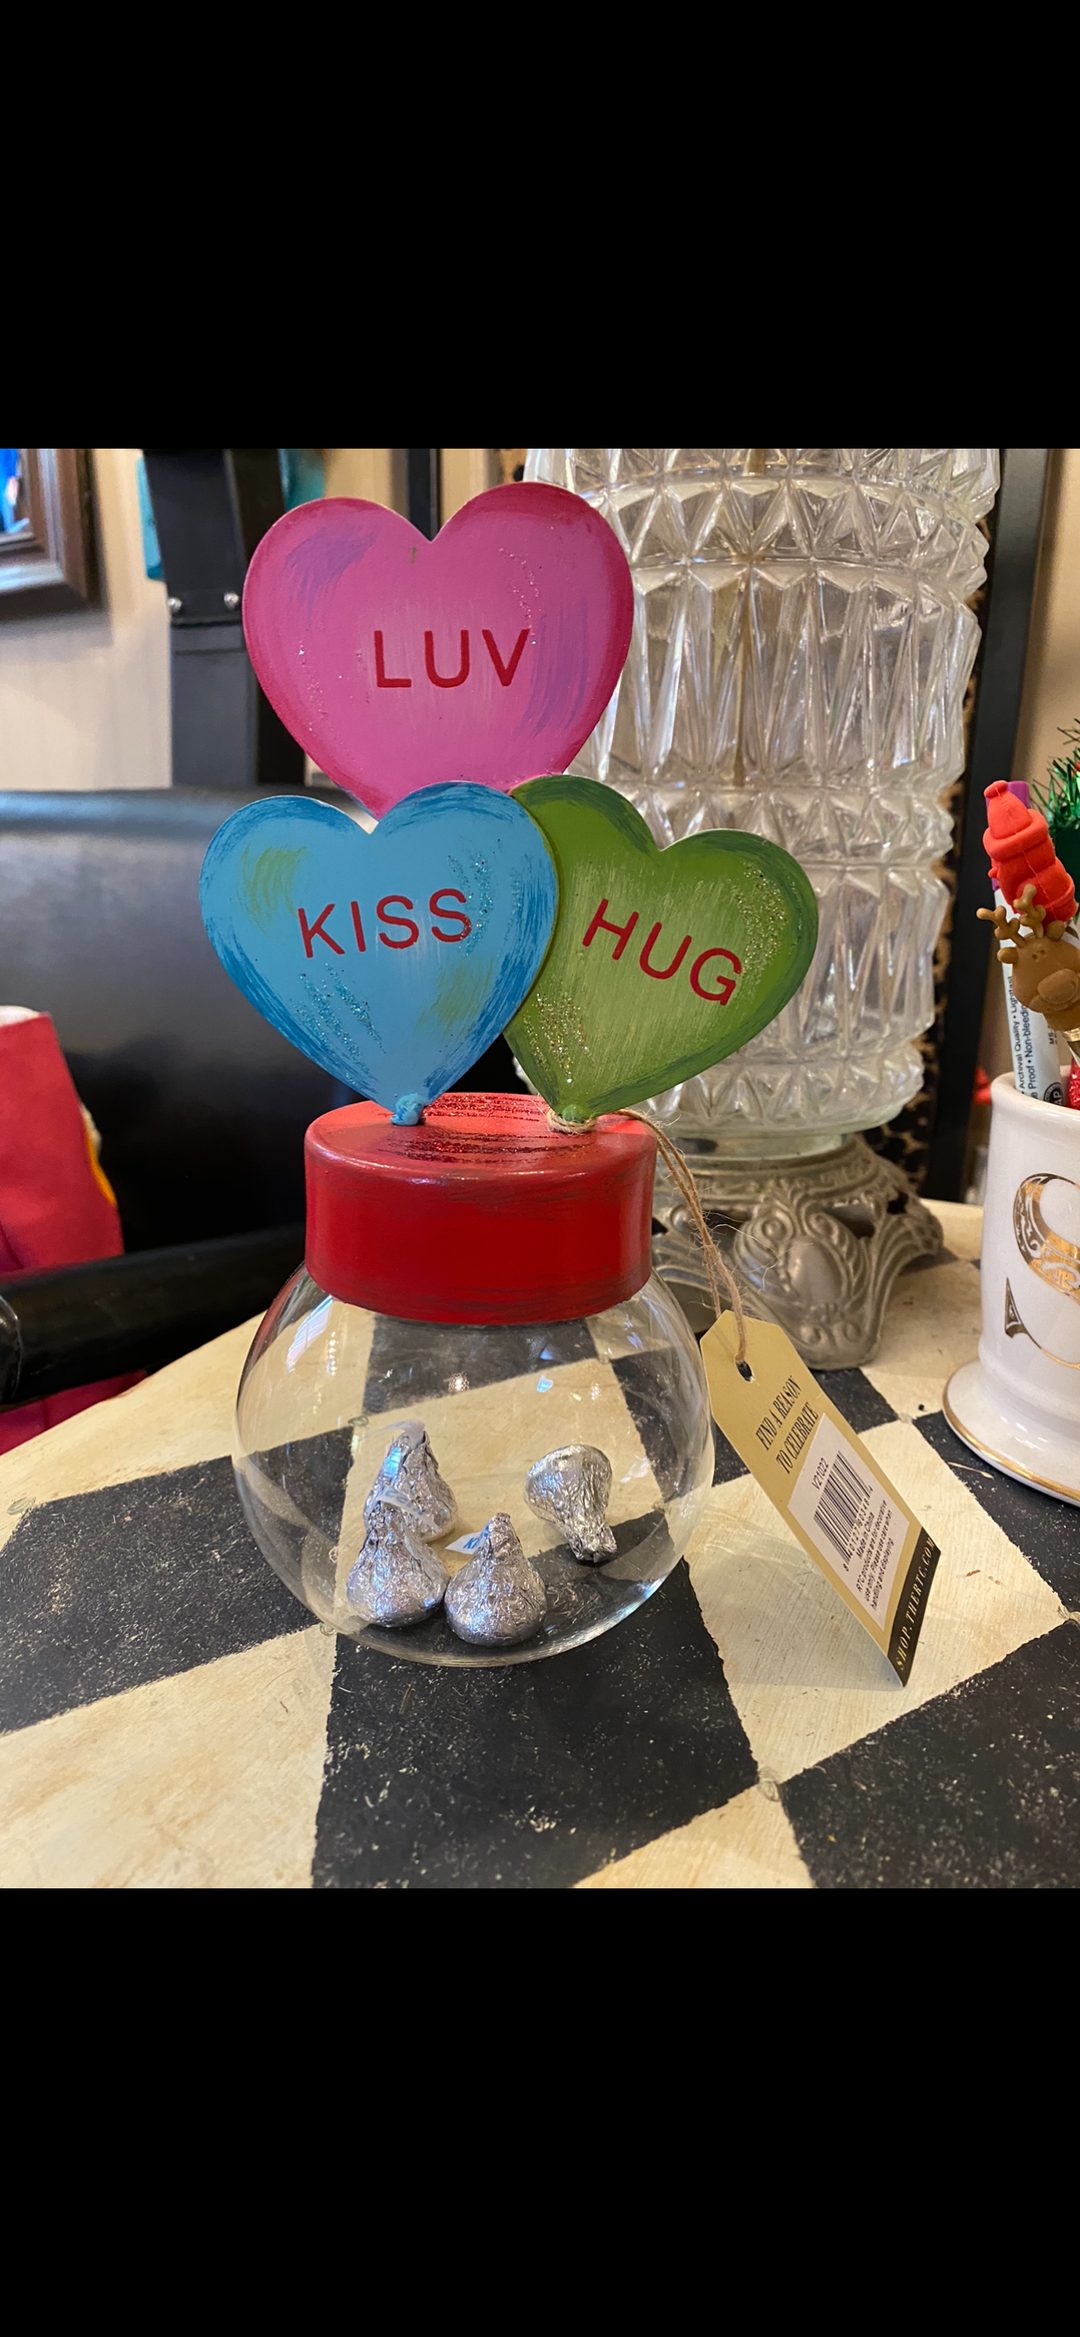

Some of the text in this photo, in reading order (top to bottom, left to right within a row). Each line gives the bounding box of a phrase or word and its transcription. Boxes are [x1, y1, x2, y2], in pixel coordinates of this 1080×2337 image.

[374, 629, 531, 688] LUV
[297, 888, 472, 959] KISS
[582, 898, 742, 1006] HUG
[1013, 1021, 1021, 1052] Quality
[1021, 1005, 1033, 1058] Non-bleedin
[1016, 1053, 1025, 1089] Archival
[1028, 1065, 1036, 1089] Proof
[755, 1375, 802, 1451] FIND A REASON
[776, 1402, 818, 1475] TO CELEBRATE
[811, 1457, 829, 1490] V21022
[856, 1539, 866, 1559] Made
[864, 1512, 875, 1532] China
[856, 1574, 865, 1592] RTC
[861, 1549, 873, 1579] products
[875, 1500, 887, 1530] decorative
[871, 1550, 880, 1573] Please
[870, 1581, 882, 1611] handling
[897, 1537, 935, 1671] SHOP.THERTC.COM
